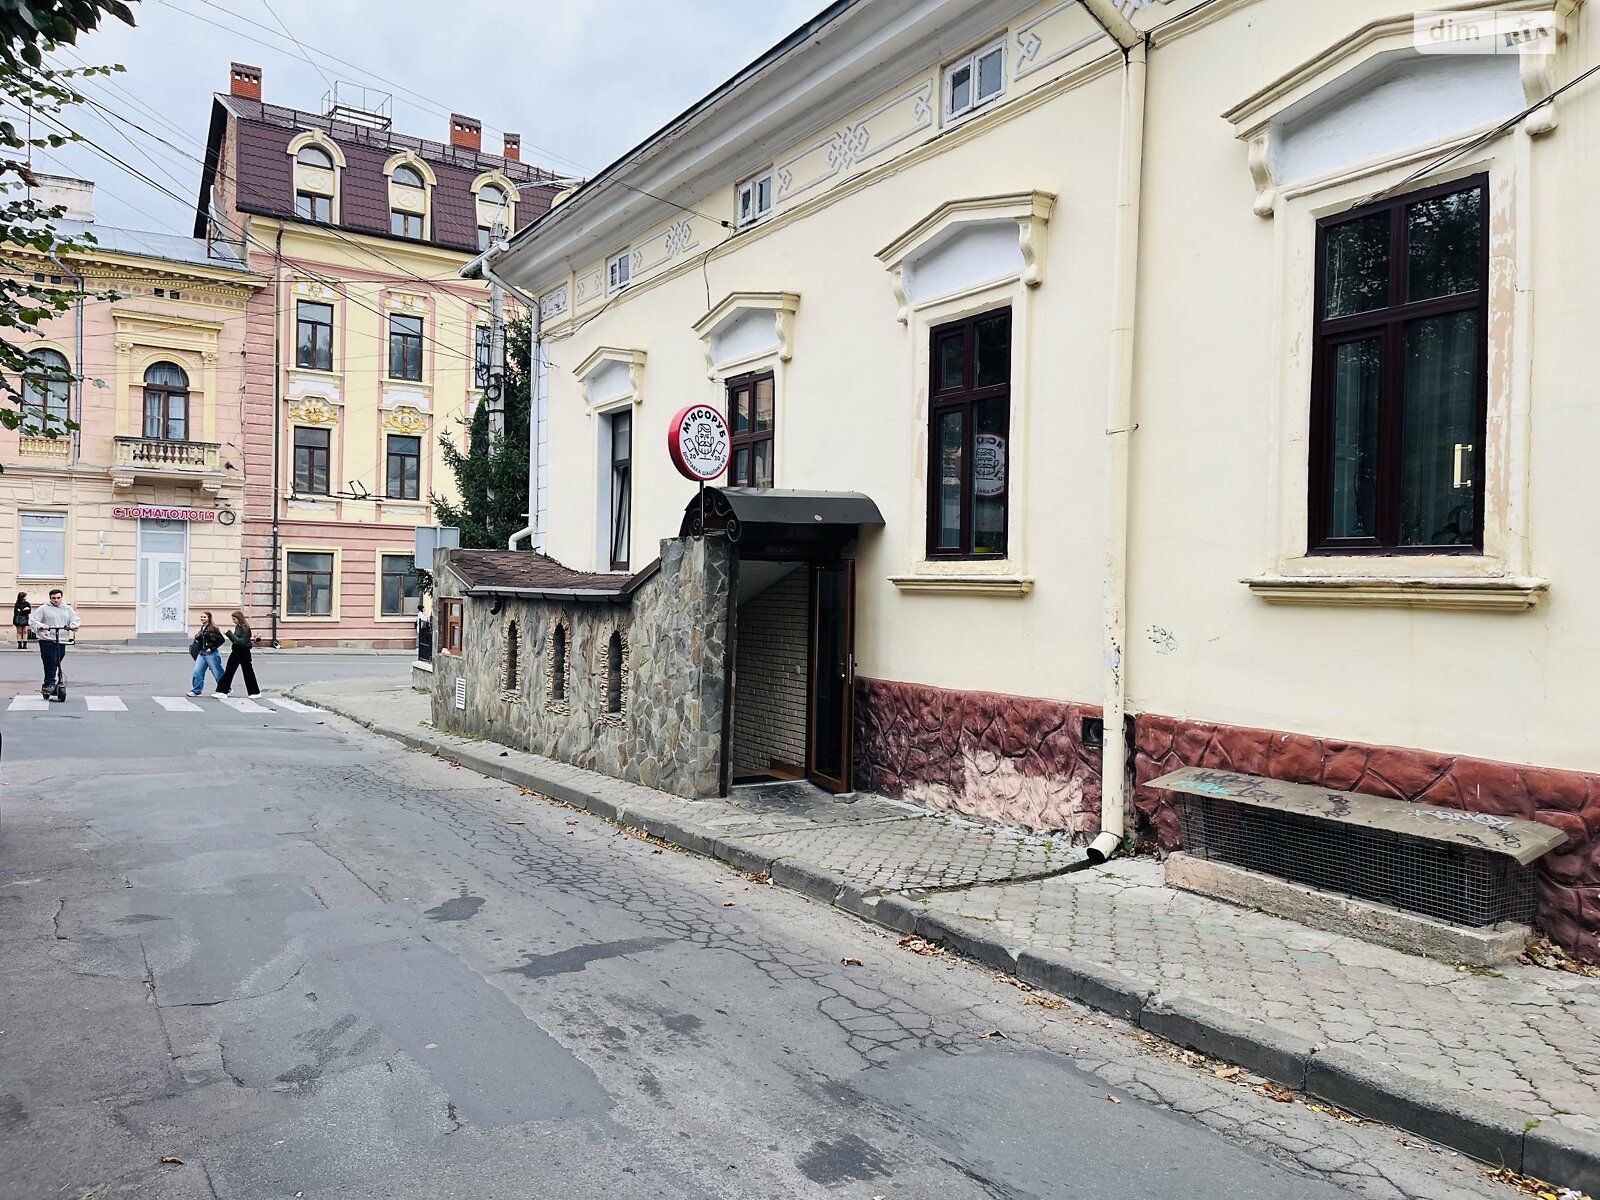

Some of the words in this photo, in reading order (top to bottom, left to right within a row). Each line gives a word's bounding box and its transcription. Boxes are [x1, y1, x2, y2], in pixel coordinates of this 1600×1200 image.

[682, 410, 726, 438] М'ЯСОРУБ
[682, 451, 701, 474] ДОСТАВКА
[112, 507, 215, 521] СТОМАТОЛОГІЯ
